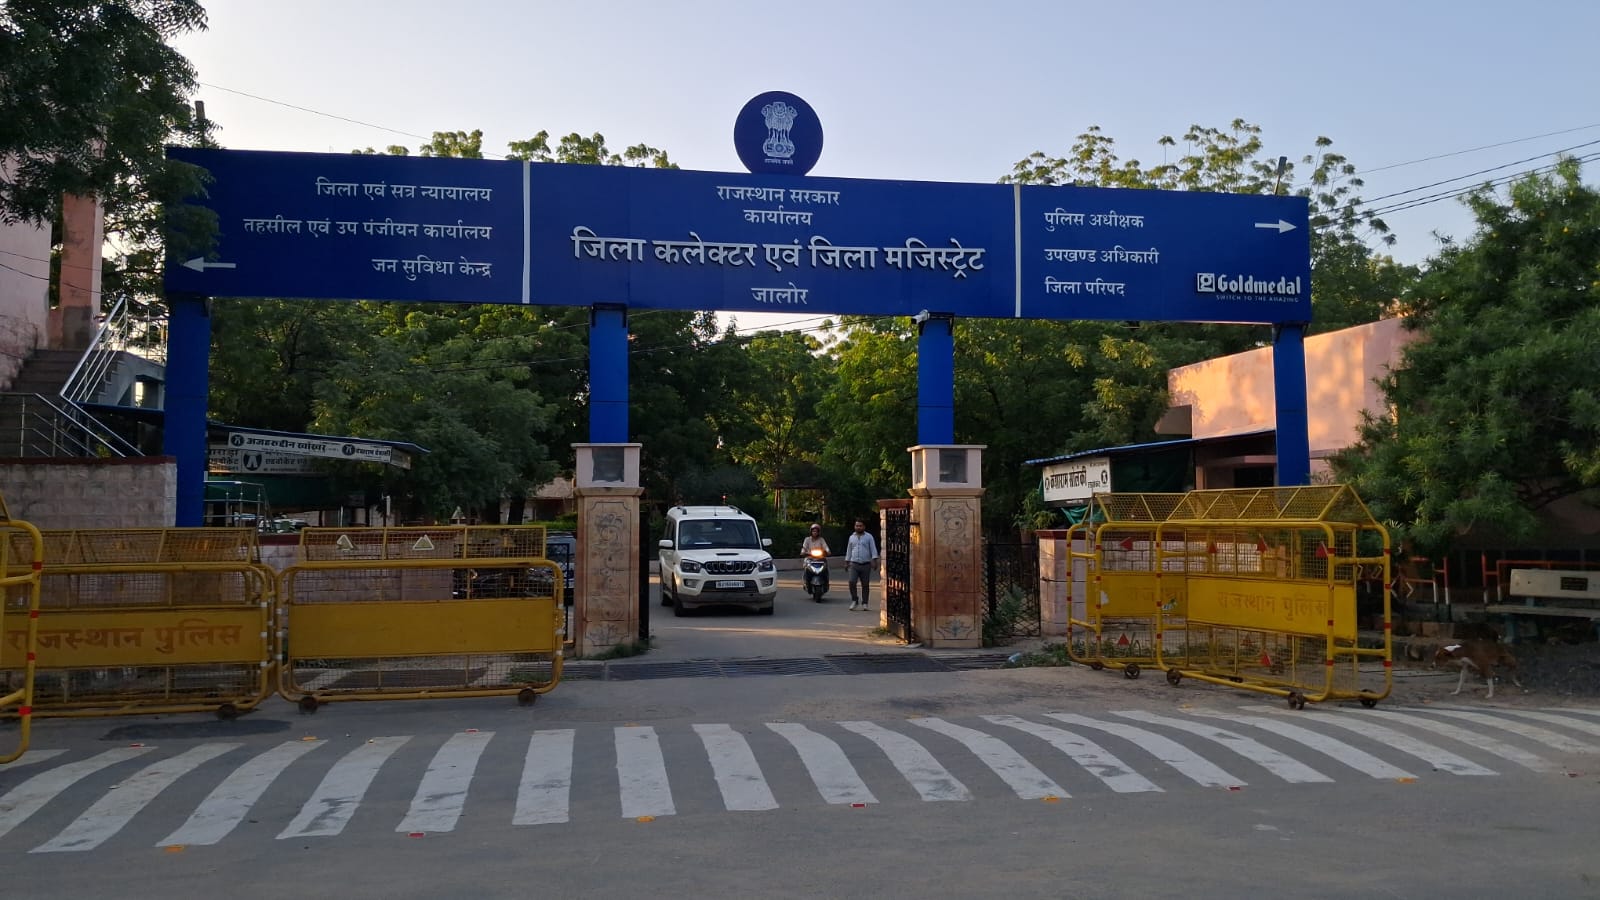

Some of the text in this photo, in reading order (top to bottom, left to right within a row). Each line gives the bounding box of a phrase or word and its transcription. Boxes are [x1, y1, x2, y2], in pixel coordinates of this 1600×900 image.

[315, 176, 493, 202] जिला एवं सत्र न्यायालय
[716, 186, 840, 206] राजस्थान सरकार
[243, 214, 493, 240] तहसील एवं उप पंजीयन कार्यालय
[743, 205, 813, 225] कार्यालय
[1043, 207, 1145, 232] पुलिस अधीक्षक
[570, 225, 986, 278] जिला कलेक्टर एवं जिला मजिस्ट्रेट
[1044, 245, 1160, 265] उपखण्ड अधिकारी
[372, 254, 492, 281] जन सुविधा केन्द्र
[750, 282, 809, 305] जालोर
[1044, 275, 1082, 294] जिला
[1217, 274, 1301, 295] Goldmedal
[152, 618, 243, 654] पुलिस
